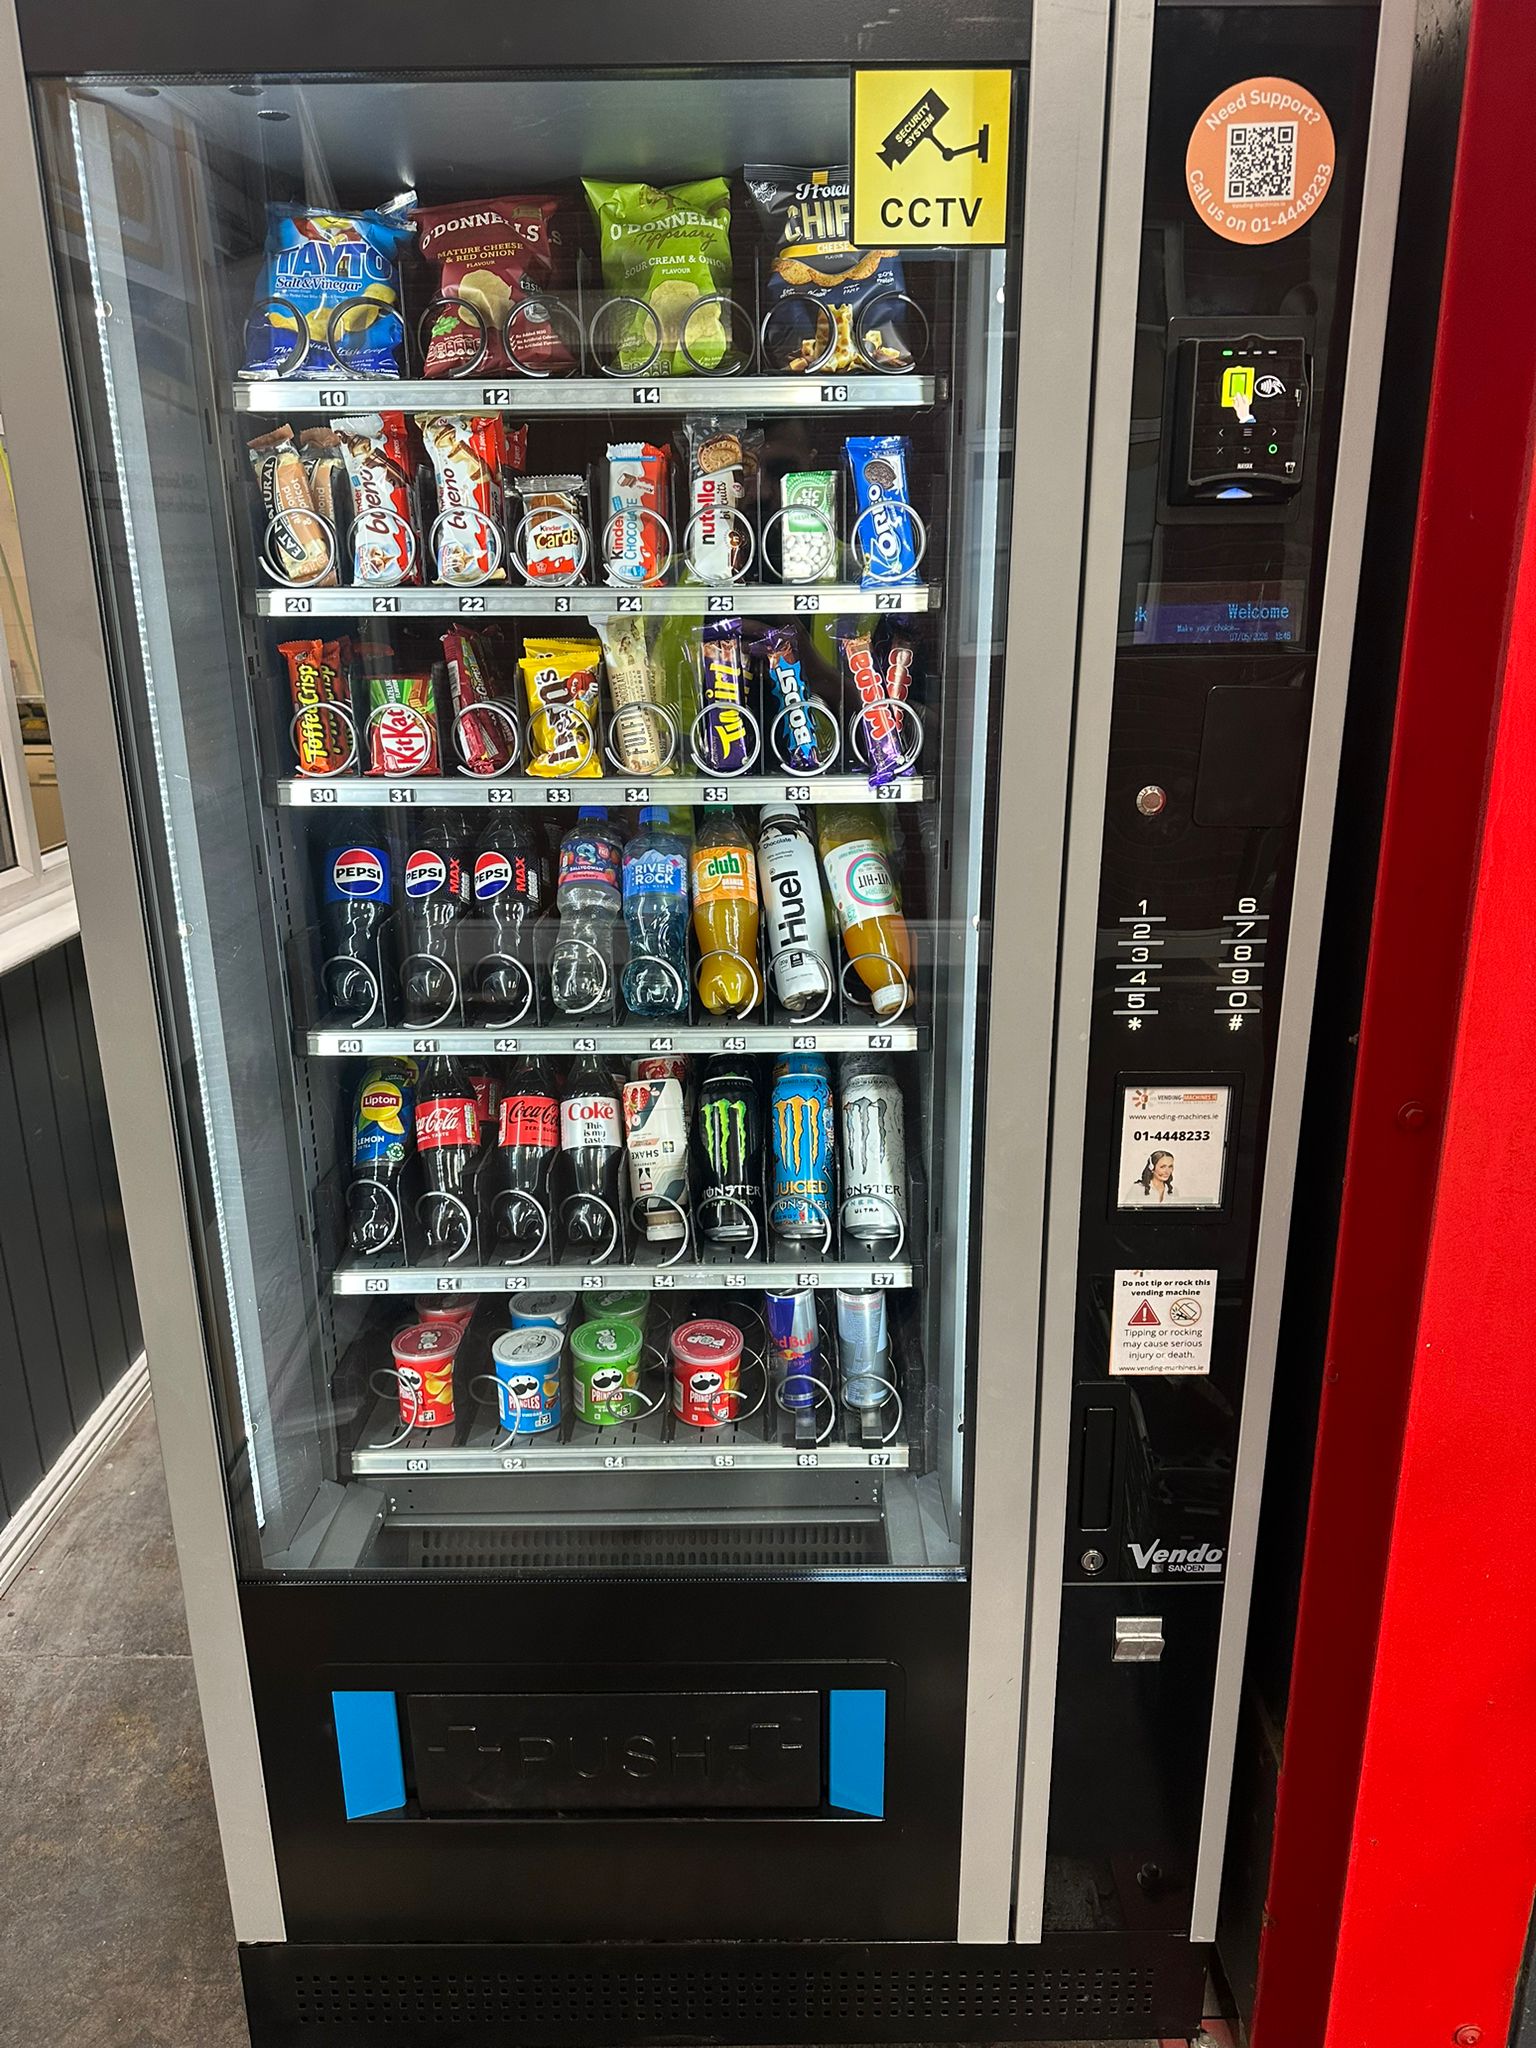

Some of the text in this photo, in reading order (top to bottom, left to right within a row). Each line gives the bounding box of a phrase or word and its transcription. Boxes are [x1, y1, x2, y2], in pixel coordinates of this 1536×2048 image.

[1206, 89, 1321, 132] Need Support?
[895, 101, 931, 143] SECURITY
[904, 113, 935, 148] SYSTEM
[1190, 163, 1331, 233] Call us on 01-4448233
[881, 197, 983, 228] CCTV
[609, 210, 728, 241] O'DONNELL
[437, 242, 524, 260] MATURE CHEESE
[456, 253, 477, 262] RED
[480, 250, 515, 259] ONION
[276, 240, 393, 281] TAYTO
[466, 260, 496, 269] FLAVOUR
[624, 262, 648, 279] SOUR
[648, 255, 686, 266] CREAM
[688, 255, 696, 263] &
[661, 267, 691, 275] FLAVOUR
[322, 392, 344, 406] 10
[485, 390, 508, 405] 12
[636, 387, 660, 403] 14
[823, 386, 847, 401] 16
[801, 488, 821, 499] tic
[797, 497, 819, 508] tac
[278, 534, 301, 558] EAT
[535, 531, 579, 549] Cards
[287, 598, 310, 612] 20
[375, 598, 396, 612] 21
[461, 598, 483, 611] 22
[556, 598, 568, 611] 3
[619, 598, 641, 611] 24
[710, 597, 733, 611] 25
[796, 596, 818, 609] 26
[878, 595, 900, 608] 27
[1228, 603, 1289, 619] Welcome
[296, 664, 320, 706] Crisp
[705, 663, 746, 759] Twirl
[776, 667, 811, 745] BOOST
[382, 709, 424, 765] KitKat
[312, 790, 334, 802] 30
[392, 790, 412, 802] 31
[491, 790, 512, 802] 32
[548, 789, 570, 802] 33
[627, 789, 648, 802] 34
[706, 788, 727, 800] 35
[788, 788, 809, 800] 36
[879, 786, 900, 799] 37
[763, 837, 792, 850] Chocolate
[635, 863, 674, 874] RIVER
[706, 851, 741, 876] club
[336, 867, 381, 880] PEPSI
[407, 868, 443, 881] PEPSI
[449, 857, 460, 894] MAX
[475, 869, 508, 884] PEPSI
[515, 856, 526, 892] MAX
[635, 873, 674, 885] ROCK
[771, 870, 808, 948] Huel
[1138, 899, 1147, 916] 1
[1238, 897, 1257, 914] 6
[1133, 924, 1150, 939] 2
[1236, 922, 1255, 937] 7
[1132, 948, 1149, 962] 3
[1233, 945, 1252, 961] 8
[1130, 970, 1147, 985] 4
[1231, 969, 1249, 984] 9
[1127, 993, 1145, 1008] 5
[1229, 992, 1247, 1007] 0
[340, 1040, 361, 1052] 40
[415, 1040, 435, 1051] 41
[496, 1040, 517, 1051] 42
[574, 1039, 595, 1051] 43
[651, 1038, 672, 1050] 44
[725, 1037, 745, 1049] 45
[794, 1037, 815, 1049] 46
[871, 1036, 892, 1047] 47
[365, 1096, 397, 1106] Lipton
[568, 1102, 614, 1121] Coke
[1129, 1113, 1219, 1121] www.vending-machines.ie
[357, 1135, 385, 1145] LEMON
[1134, 1131, 1210, 1141] 01-4448233
[632, 1149, 659, 1160] SHAKE
[775, 1180, 829, 1195] JUICED
[367, 1279, 387, 1291] 50
[438, 1279, 457, 1290] 51
[507, 1278, 527, 1289] 52
[583, 1277, 602, 1288] 53
[654, 1276, 674, 1287] 54
[726, 1275, 745, 1286] 55
[800, 1274, 819, 1285] 56
[874, 1273, 893, 1284] 57
[1151, 1279, 1162, 1287] tip
[789, 1328, 814, 1348] Bull
[1124, 1329, 1156, 1338] Tipping
[1170, 1329, 1203, 1337] rocking
[1129, 1352, 1154, 1360] injury
[408, 1460, 427, 1470] 60
[503, 1459, 522, 1469] 62
[605, 1458, 623, 1468] 64
[715, 1456, 733, 1466] 65
[798, 1455, 818, 1465] 66
[870, 1455, 889, 1465] 67
[1127, 1538, 1222, 1569] Vendo
[1168, 1564, 1205, 1573] SANDEN
[519, 1734, 711, 1779] PUSH
